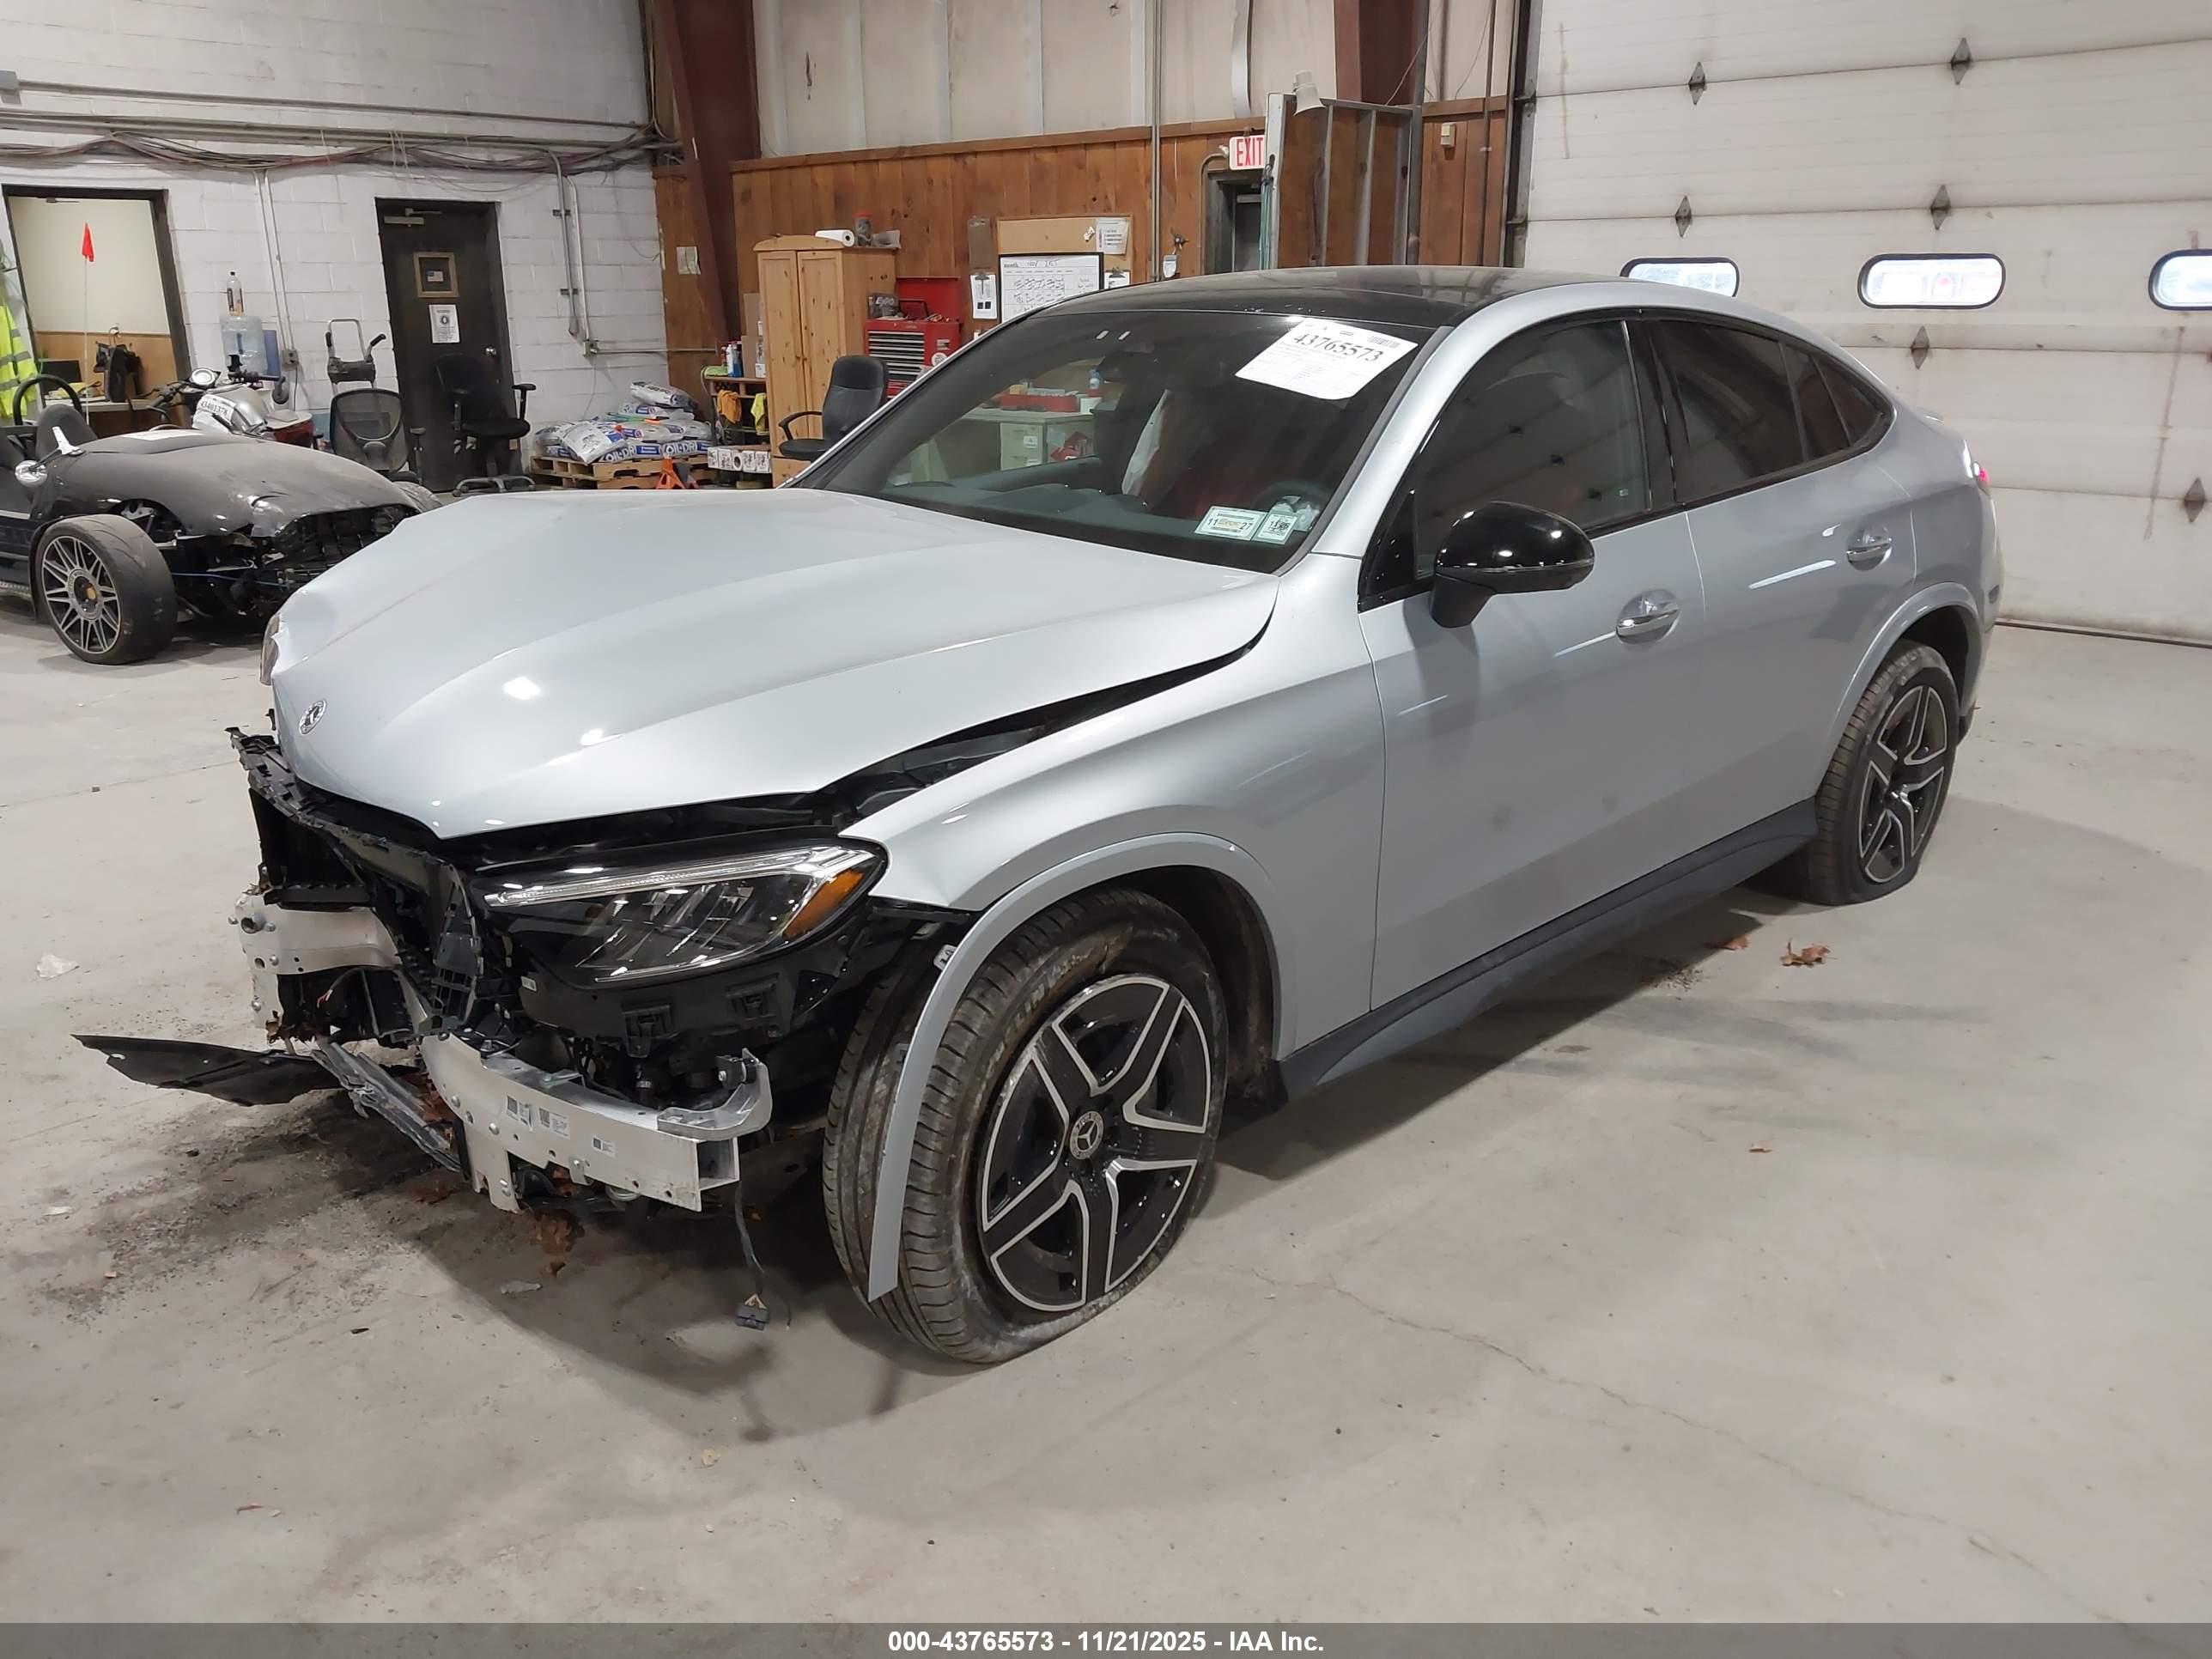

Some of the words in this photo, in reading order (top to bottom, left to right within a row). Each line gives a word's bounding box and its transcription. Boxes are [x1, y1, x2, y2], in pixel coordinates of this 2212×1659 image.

[1237, 137, 1264, 167] EXIT
[1294, 333, 1384, 362] 43765573
[1207, 518, 1219, 527] 11
[1239, 521, 1253, 531] 27
